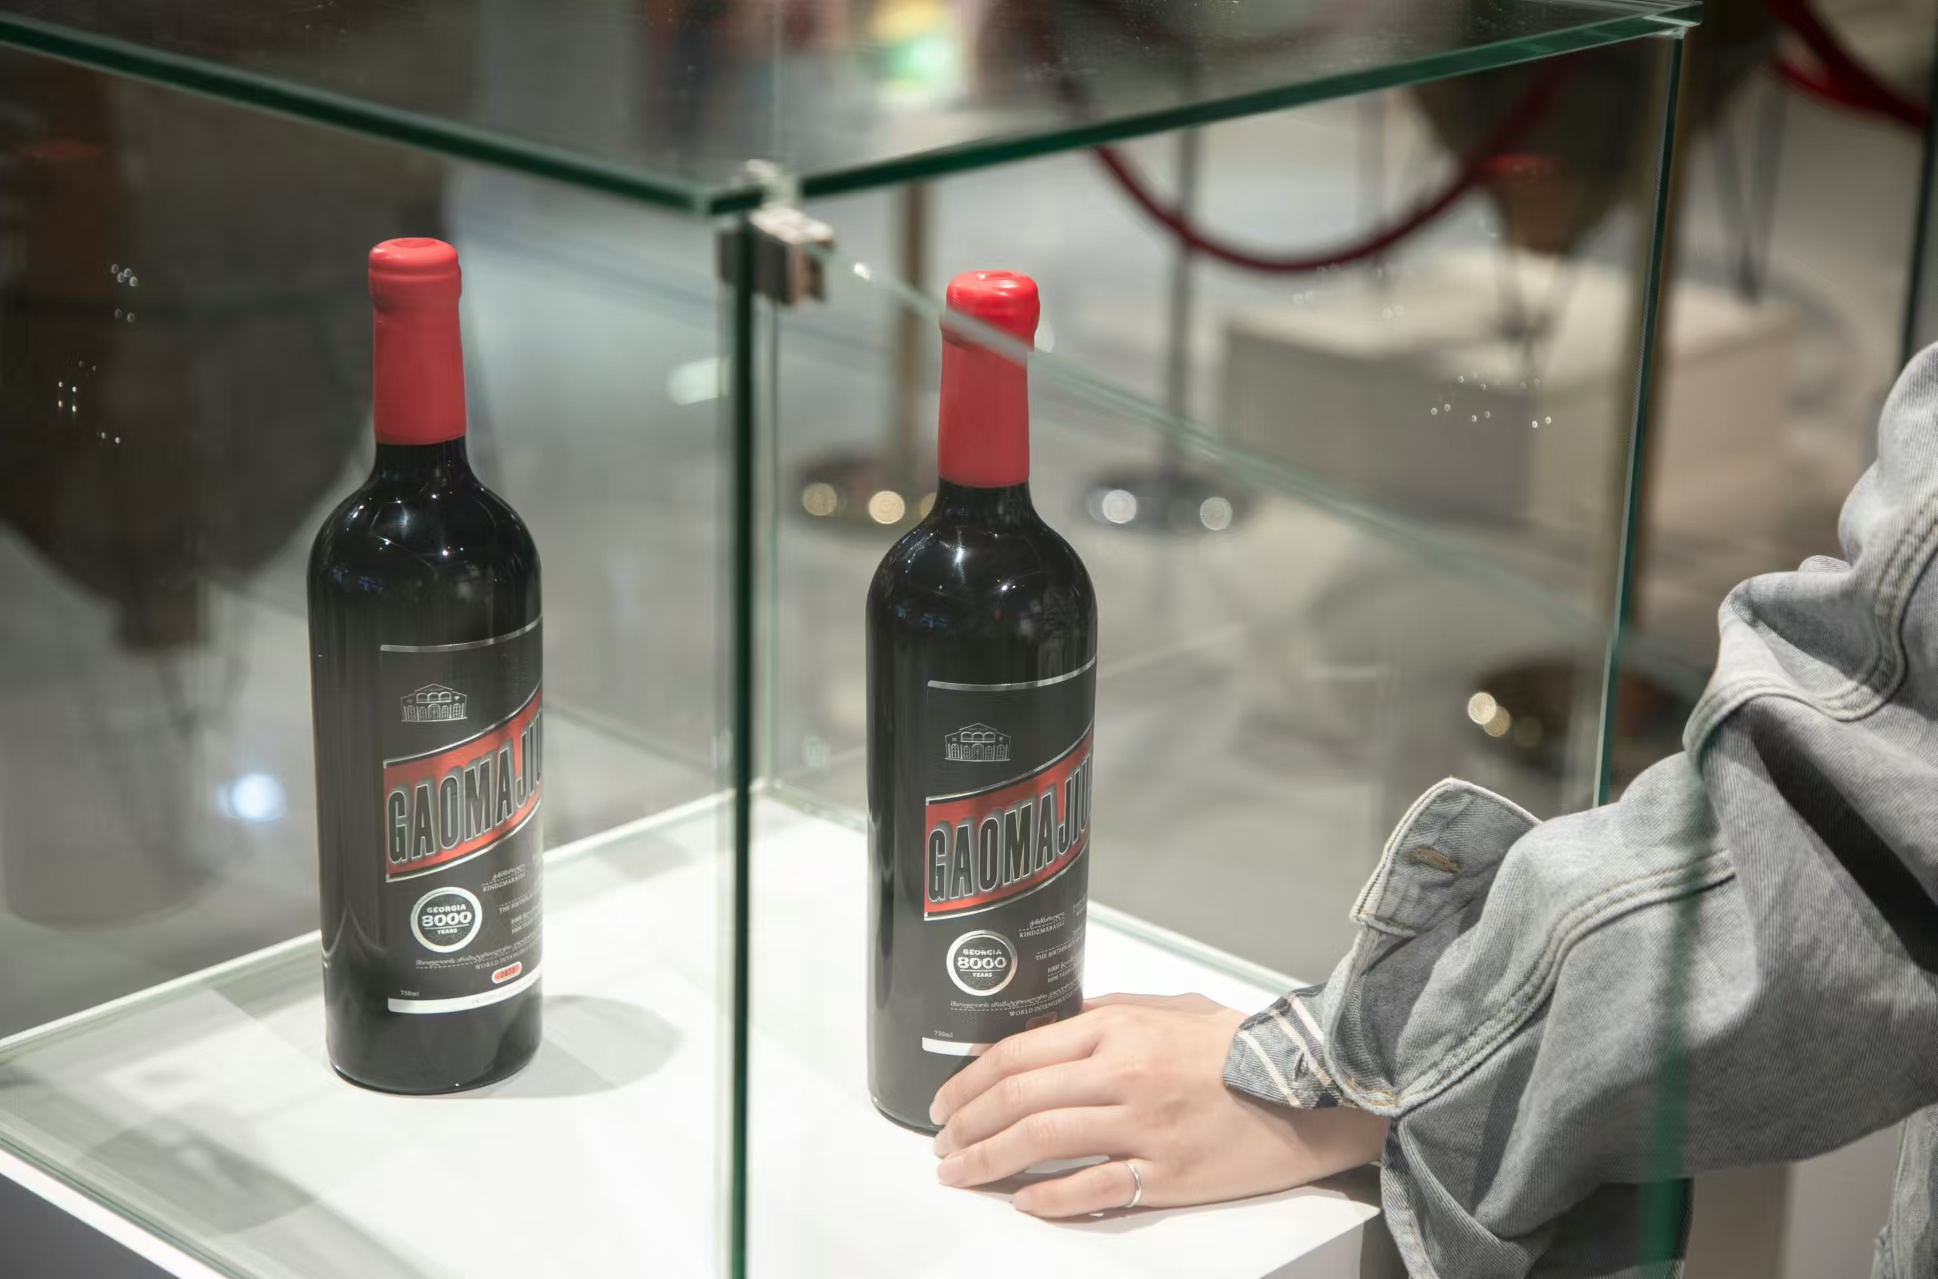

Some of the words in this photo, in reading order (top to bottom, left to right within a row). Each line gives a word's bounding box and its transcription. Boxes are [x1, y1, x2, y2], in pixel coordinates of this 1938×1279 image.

[426, 903, 467, 913] GEORGIA
[421, 911, 472, 927] 8000
[957, 957, 1007, 969] 8000
[1009, 1008, 1034, 1017] WORLD
[934, 1029, 953, 1038] 750ml
